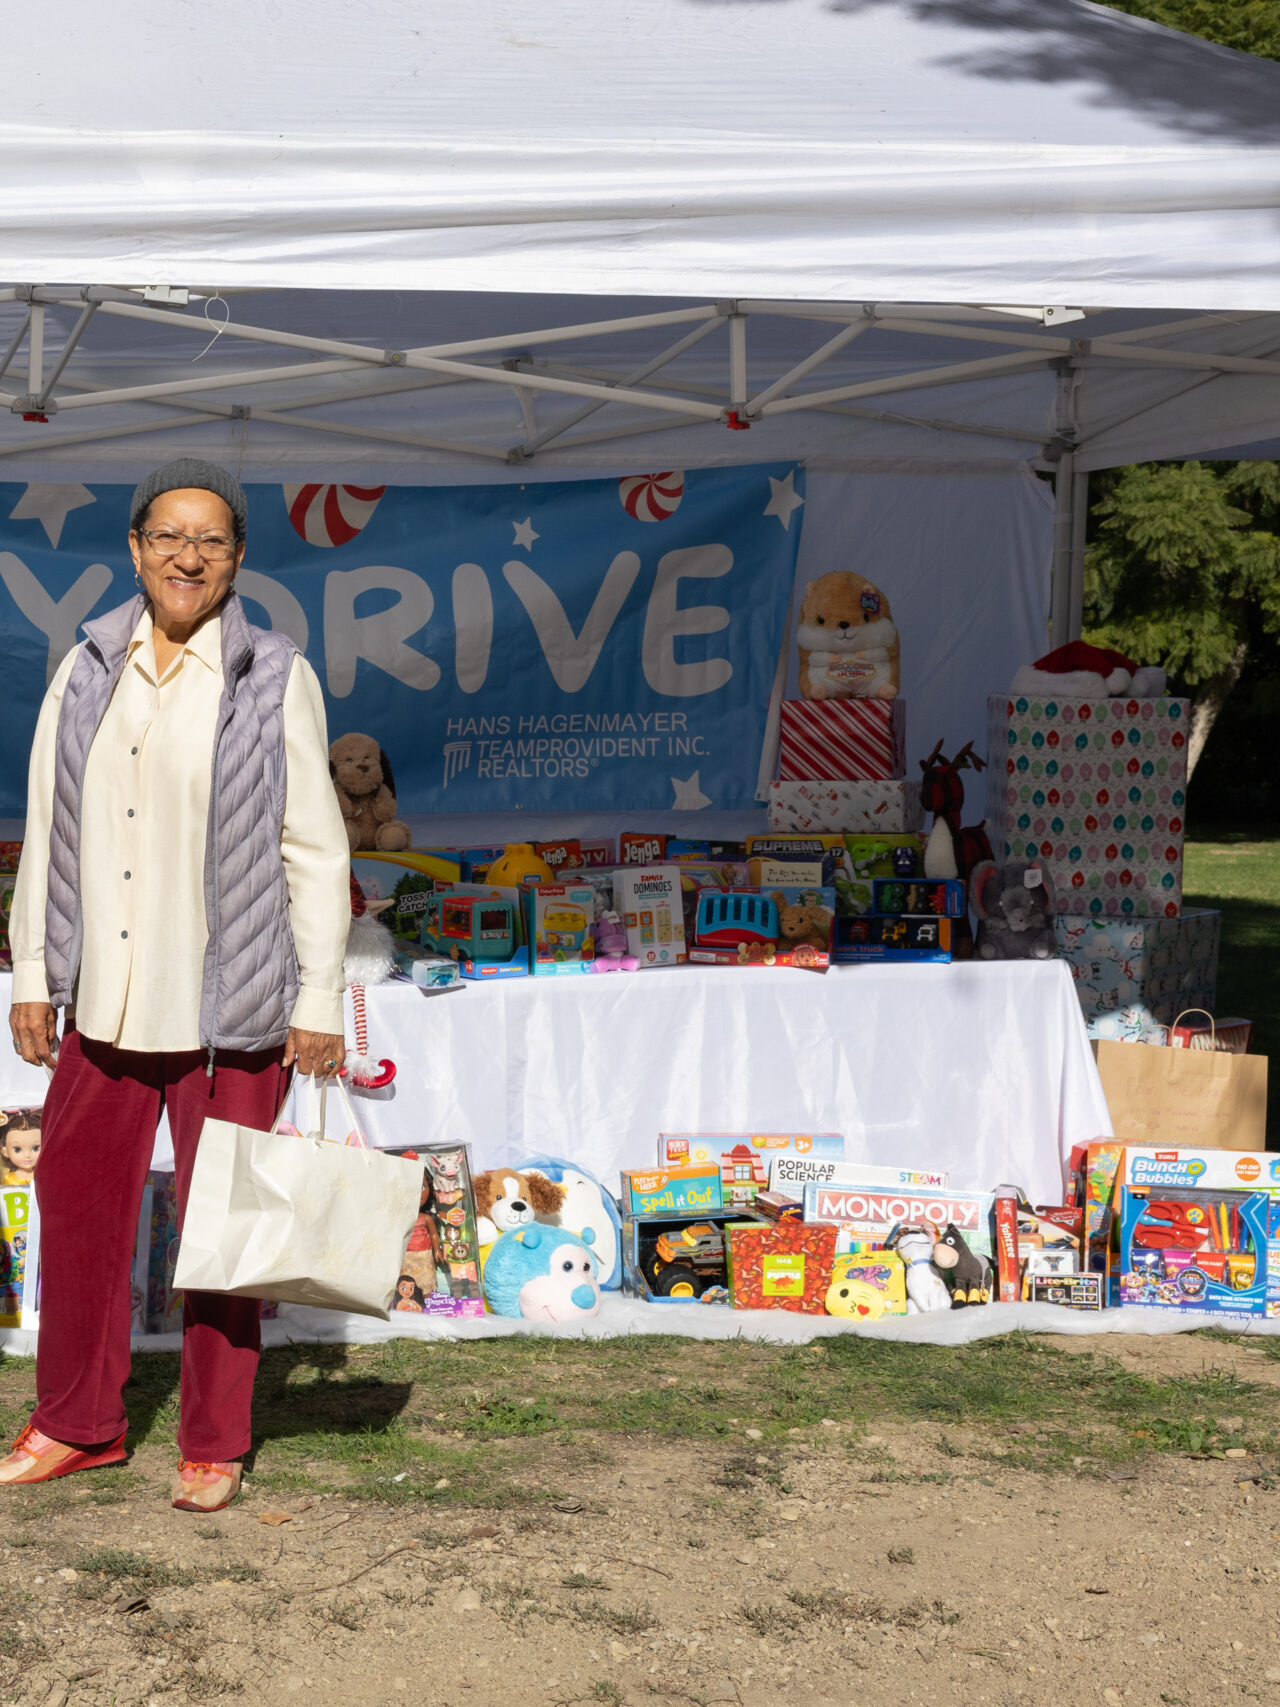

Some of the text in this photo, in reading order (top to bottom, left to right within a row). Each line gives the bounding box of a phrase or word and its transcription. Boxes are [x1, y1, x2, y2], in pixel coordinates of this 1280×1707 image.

[233, 543, 734, 698] RIVE
[446, 712, 688, 736] HANS HAGENMAYER
[477, 736, 710, 758] TEAMPROVIDENT INC.
[624, 840, 660, 864] Jenga
[752, 840, 824, 852] SUPREME
[542, 847, 568, 865] Jenga
[634, 881, 672, 894] DOMINOES
[401, 894, 424, 904] TOSS
[778, 1160, 836, 1174] POPULAR
[779, 1170, 832, 1182] SCIENCE
[900, 1172, 941, 1186] STEAM
[1135, 1172, 1194, 1185] Bubbles
[640, 1192, 674, 1212] Spell
[676, 1194, 685, 1206] it
[687, 1186, 712, 1204] Out
[822, 1194, 976, 1228] MONOPOLY
[1000, 1222, 1015, 1258] Yahtzee
